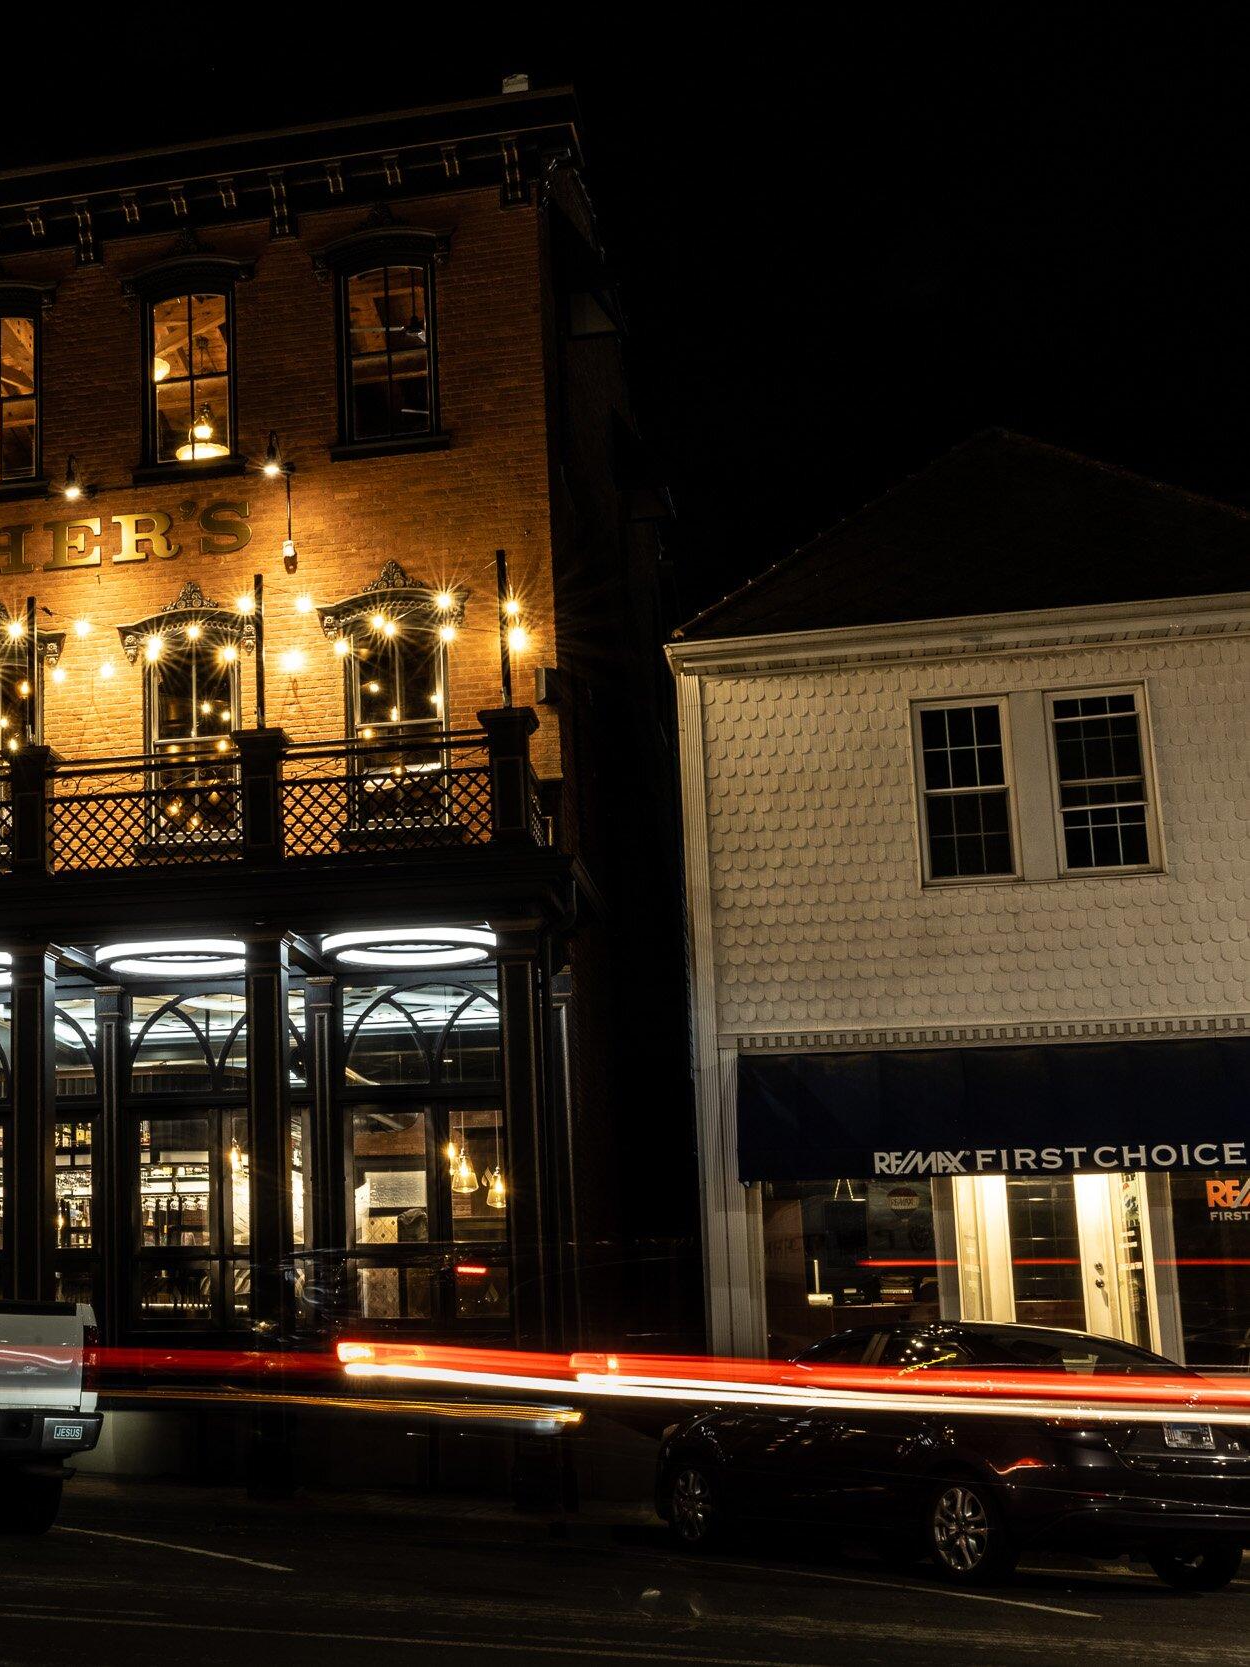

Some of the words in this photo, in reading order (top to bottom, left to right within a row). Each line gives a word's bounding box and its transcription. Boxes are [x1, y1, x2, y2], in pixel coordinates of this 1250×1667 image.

[975, 1146, 1087, 1171] FIRST
[1093, 1142, 1247, 1169] CHOICE
[1210, 1211, 1250, 1221] FIRST
[56, 1428, 80, 1438] JESUS
